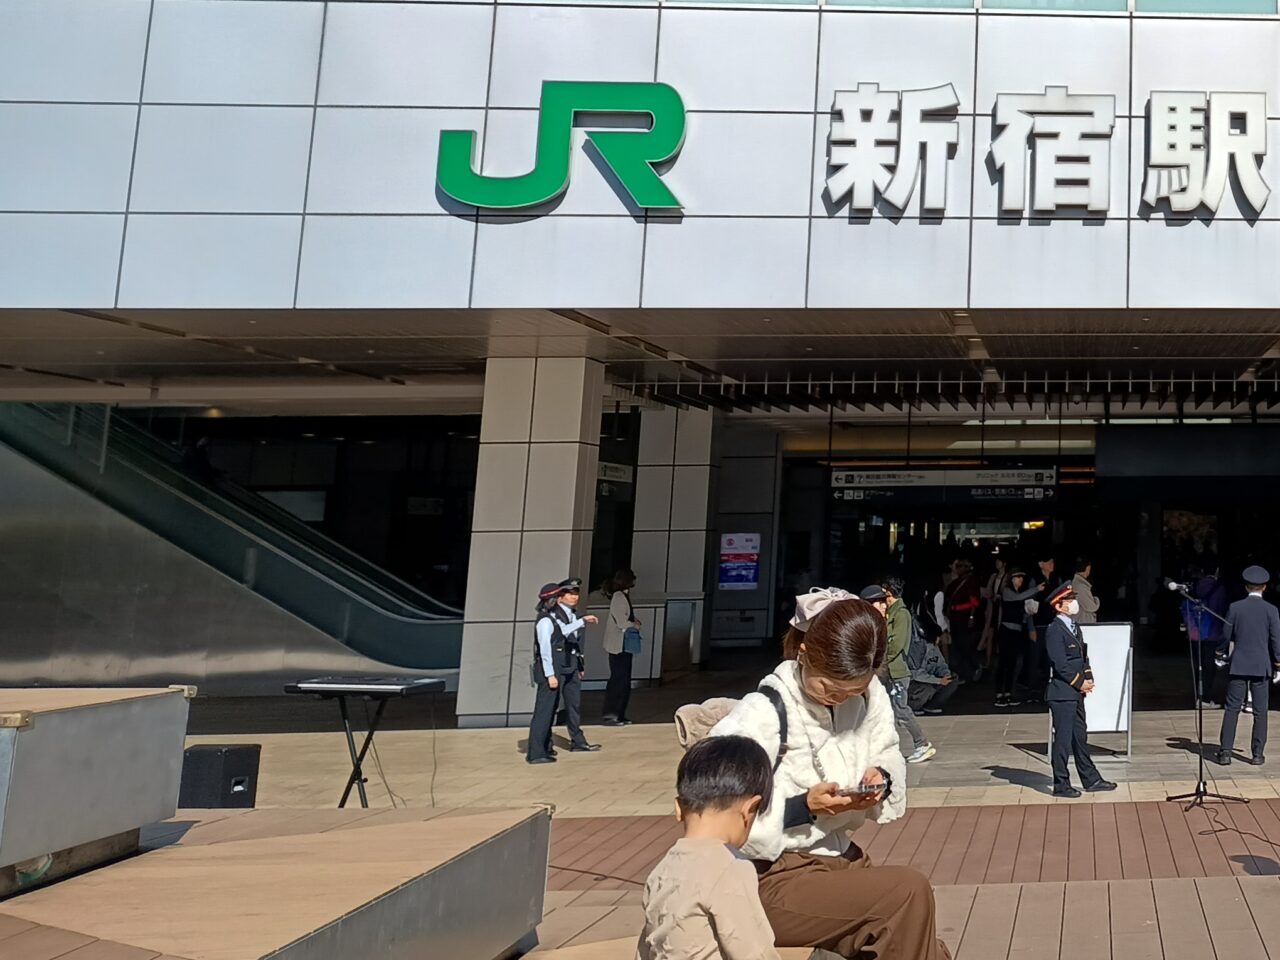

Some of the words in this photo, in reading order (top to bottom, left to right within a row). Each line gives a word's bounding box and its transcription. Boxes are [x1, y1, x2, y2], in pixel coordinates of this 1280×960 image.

[436, 80, 686, 209] JR
[825, 82, 1272, 214] 新宿駅
